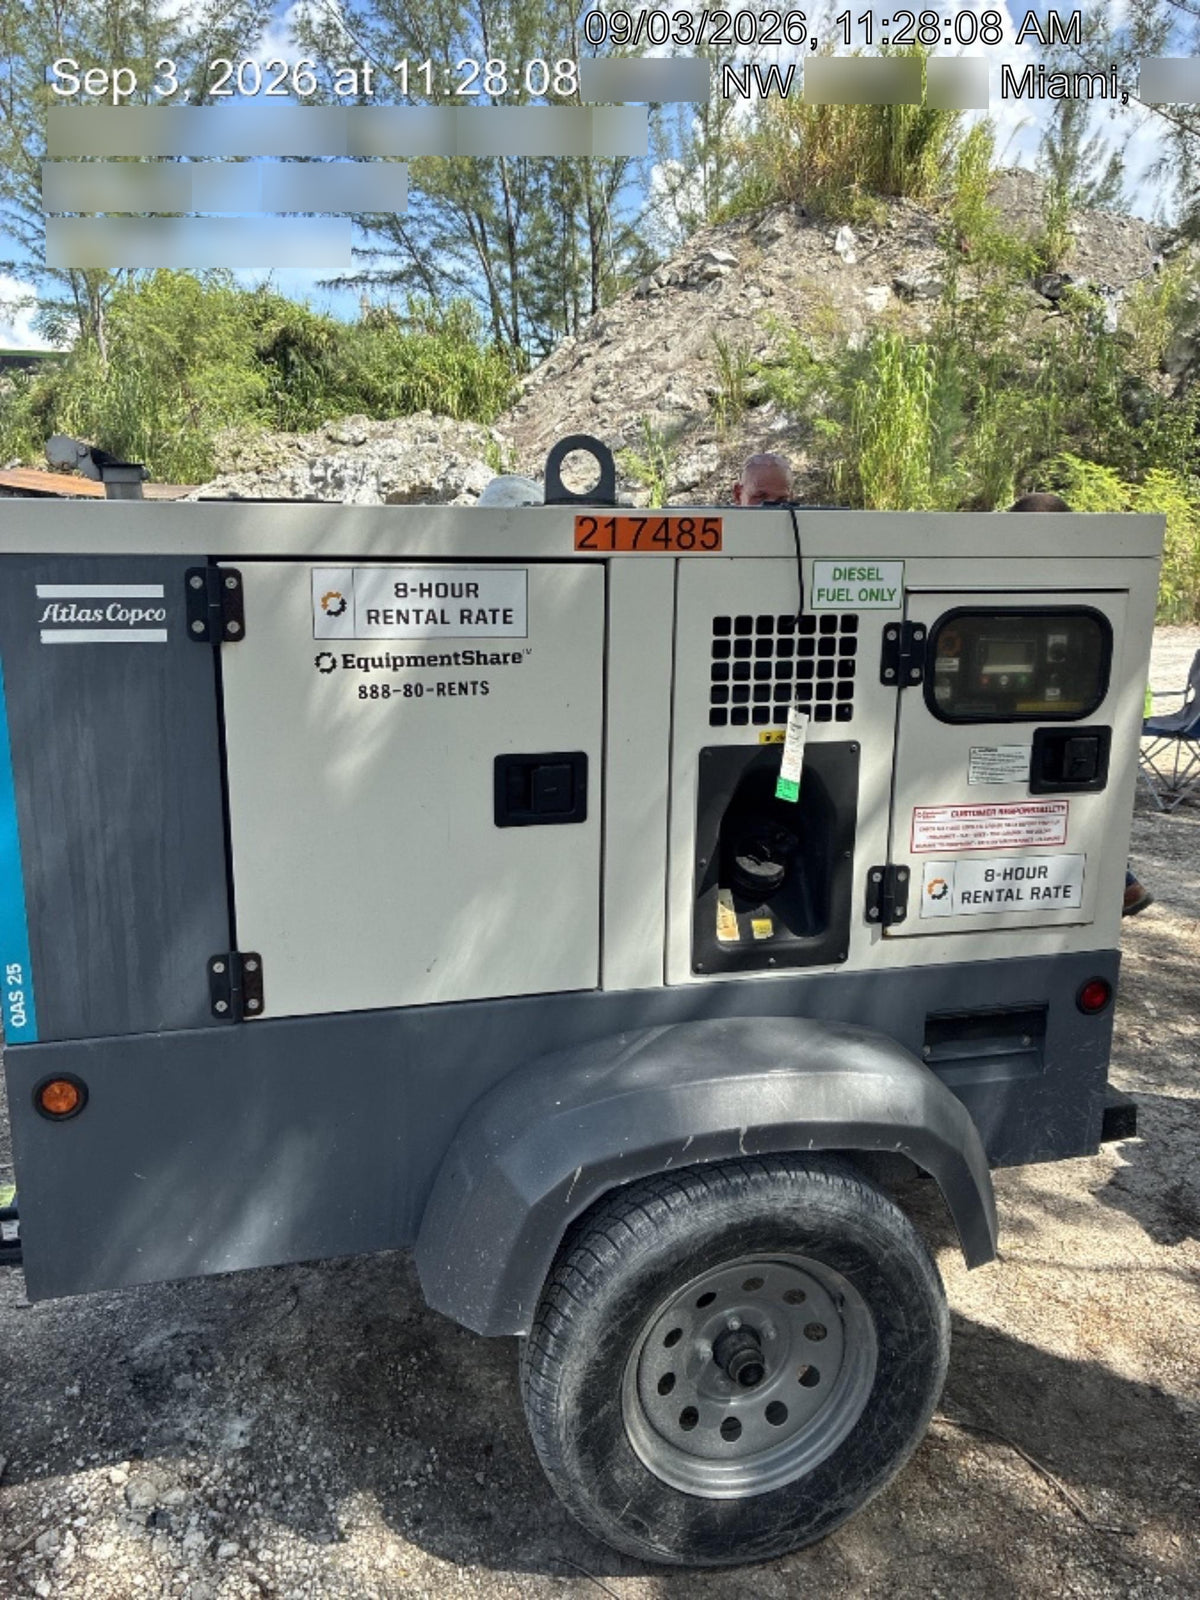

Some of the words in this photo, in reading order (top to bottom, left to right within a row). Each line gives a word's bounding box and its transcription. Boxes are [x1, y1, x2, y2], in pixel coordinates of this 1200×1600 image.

[577, 517, 720, 549] 217485
[832, 567, 884, 581] DIESEL
[394, 582, 480, 599] 8-HOUR
[817, 588, 854, 602] FUEL
[858, 588, 897, 602] ONLY
[38, 603, 104, 623] Atlas
[105, 602, 166, 625] Copco
[366, 609, 451, 625] RENTAL
[459, 608, 514, 625] RATE
[358, 681, 490, 700] 888-80-RENTS
[984, 865, 1048, 882] 8-HOUR
[961, 888, 1024, 905] RENTAL
[1030, 885, 1073, 901] RATE
[6, 963, 22, 985] 25
[8, 990, 27, 1028] QAS
